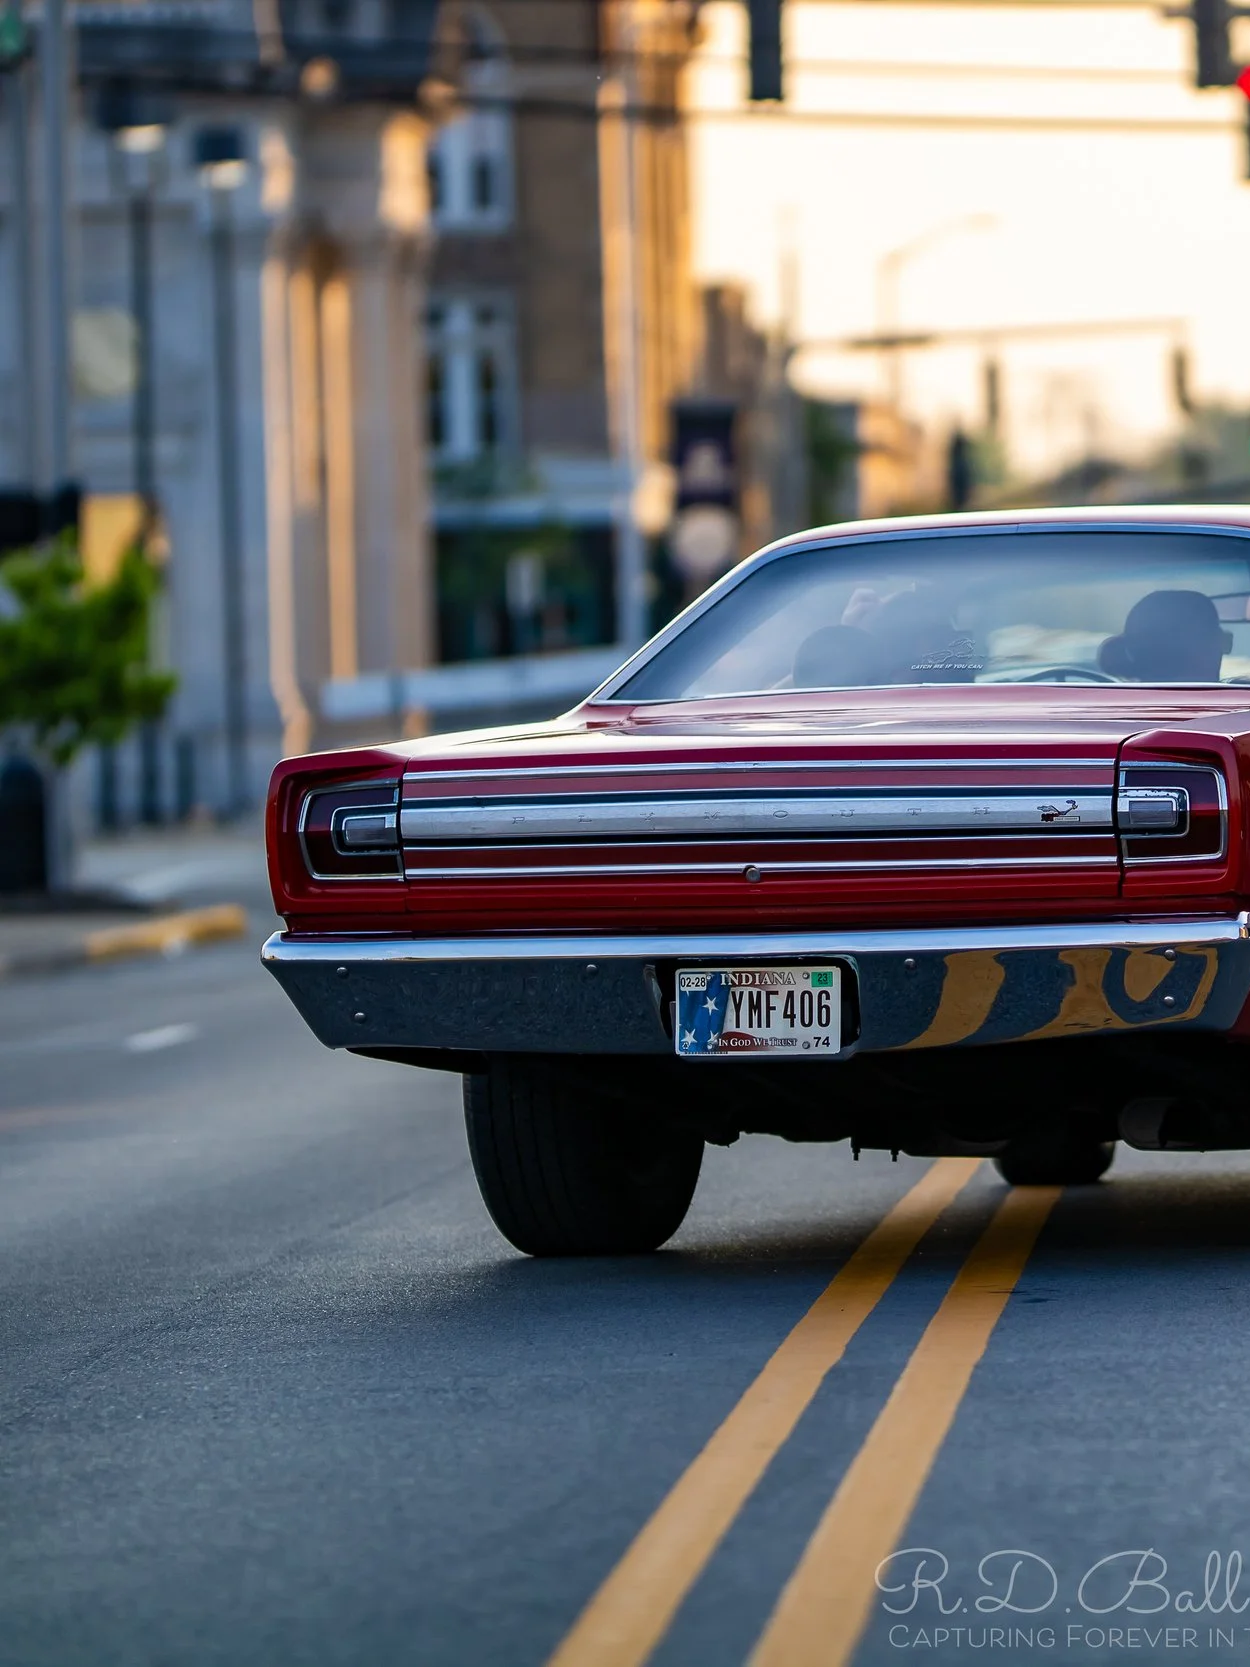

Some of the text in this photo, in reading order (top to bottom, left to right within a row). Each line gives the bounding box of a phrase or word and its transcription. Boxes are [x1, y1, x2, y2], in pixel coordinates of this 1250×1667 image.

[512, 806, 991, 825] PLYMOUTH
[680, 977, 706, 988] 02-28
[720, 972, 796, 986] INDIANA
[817, 973, 828, 982] 23
[730, 990, 831, 1029] YMF406
[718, 1037, 798, 1047] IN GOD WE TRUST
[813, 1036, 831, 1048] 74
